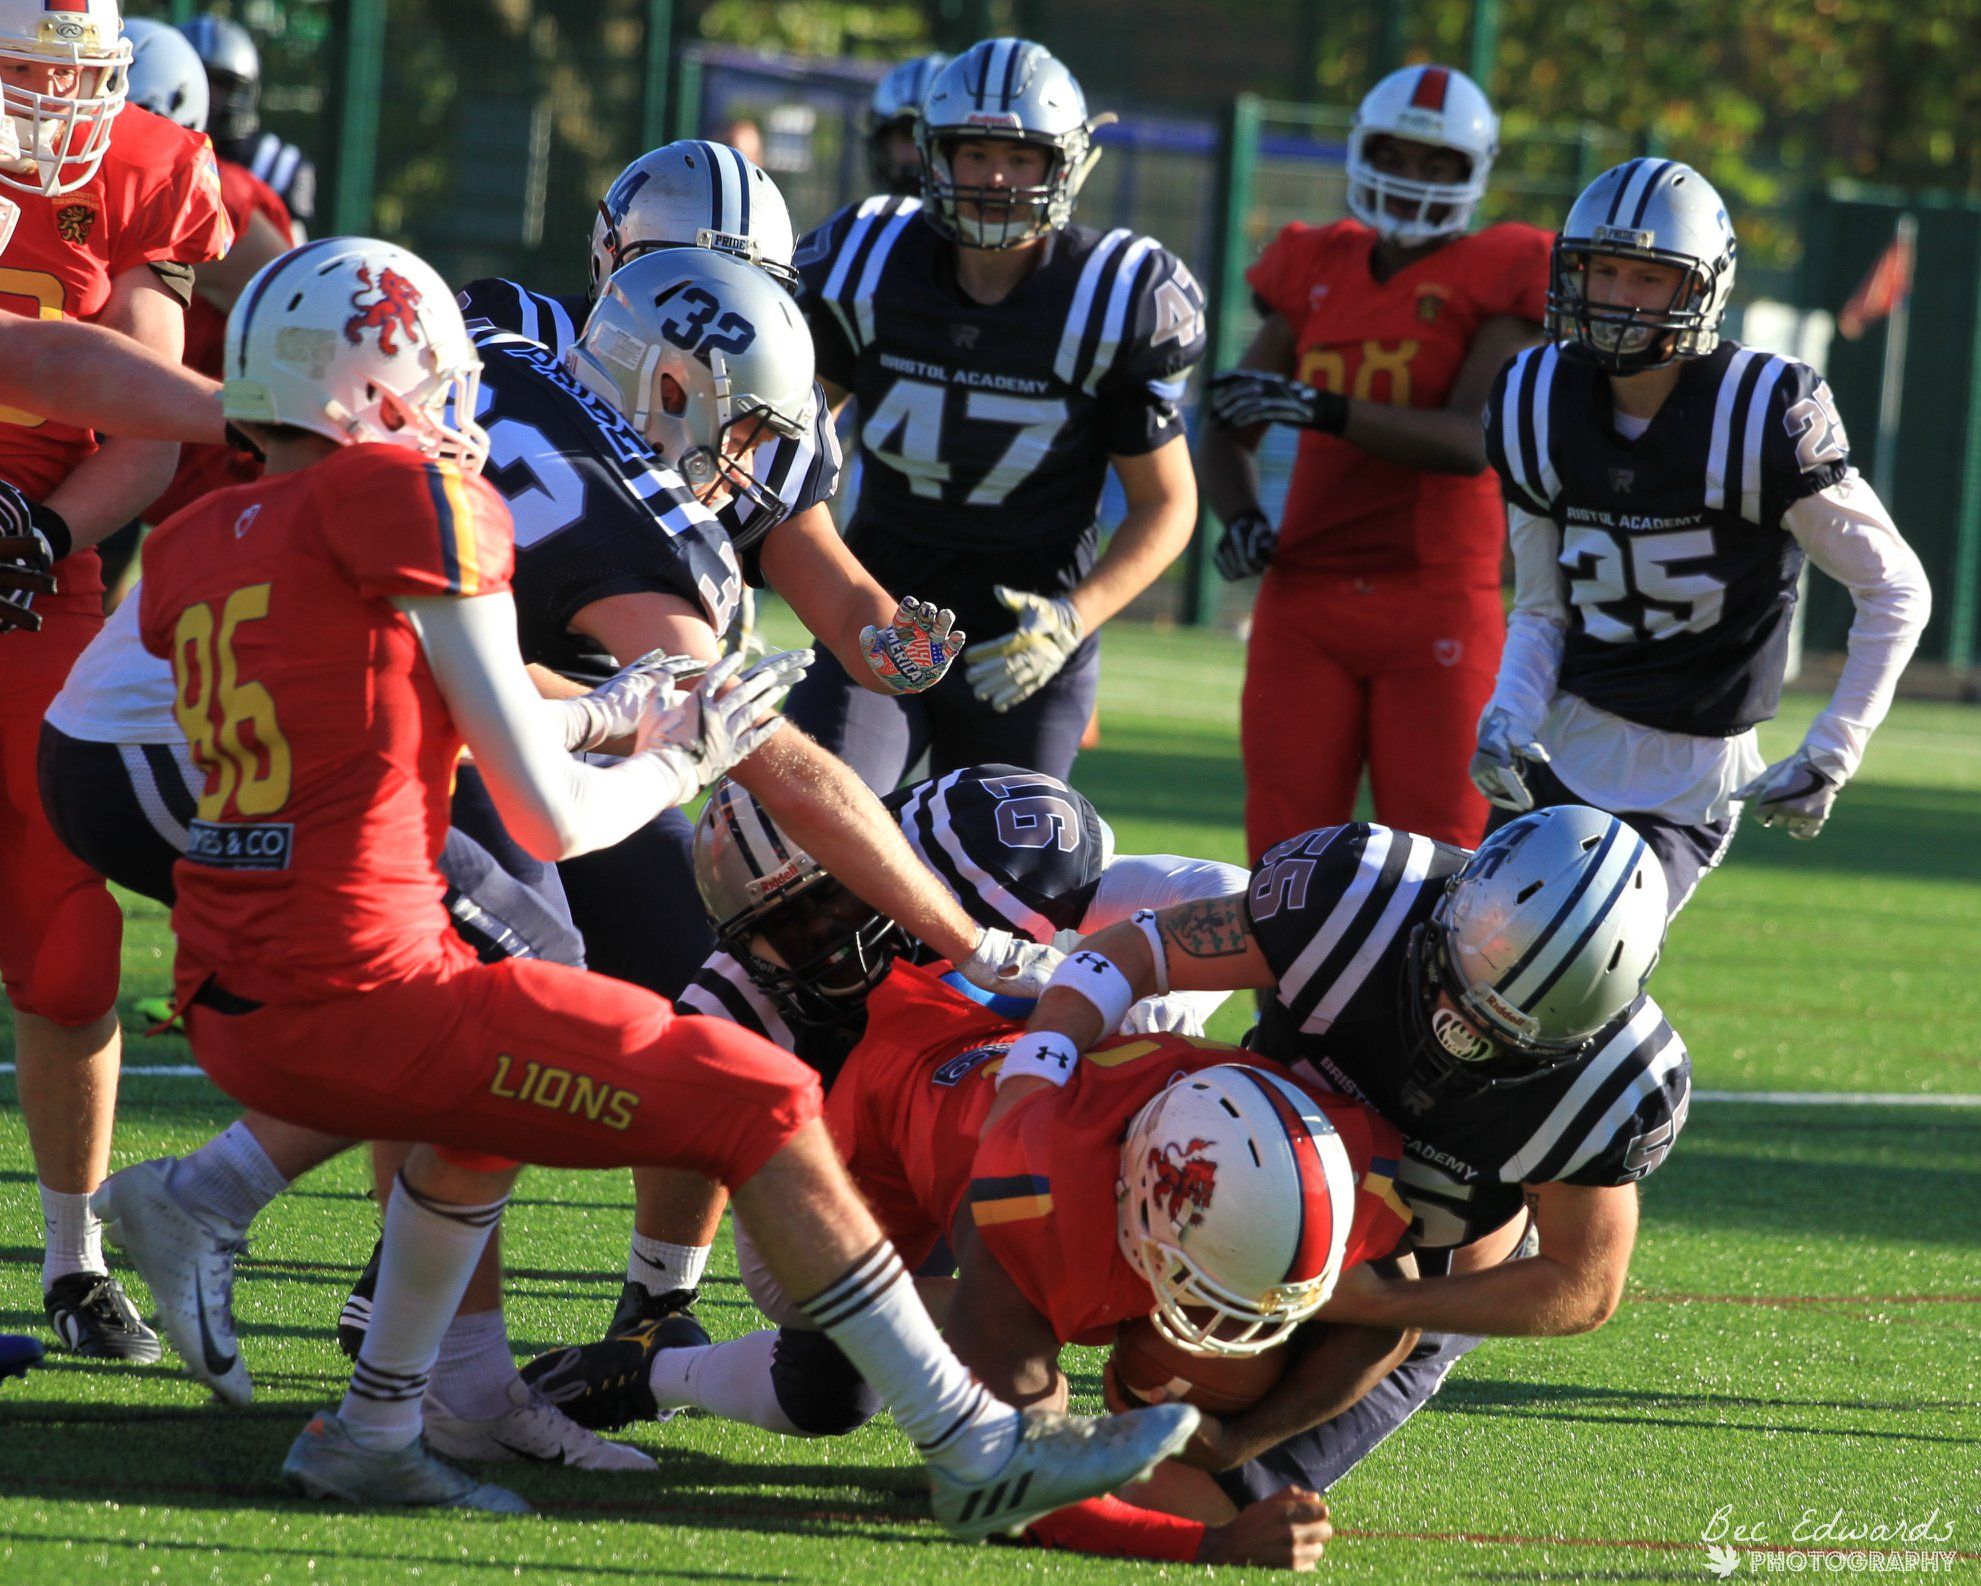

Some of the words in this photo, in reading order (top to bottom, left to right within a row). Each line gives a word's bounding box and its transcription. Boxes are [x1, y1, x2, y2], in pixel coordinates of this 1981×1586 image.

[715, 234, 747, 250] PRIDE
[660, 286, 756, 372] 32
[952, 369, 1051, 395] ACADEMY
[861, 378, 1070, 506] 47
[1618, 513, 1704, 531] ACADEMY
[1558, 524, 1728, 645] 25
[246, 829, 285, 856] CO
[1486, 993, 1526, 1028] Riddell
[489, 1053, 641, 1131] LIONS
